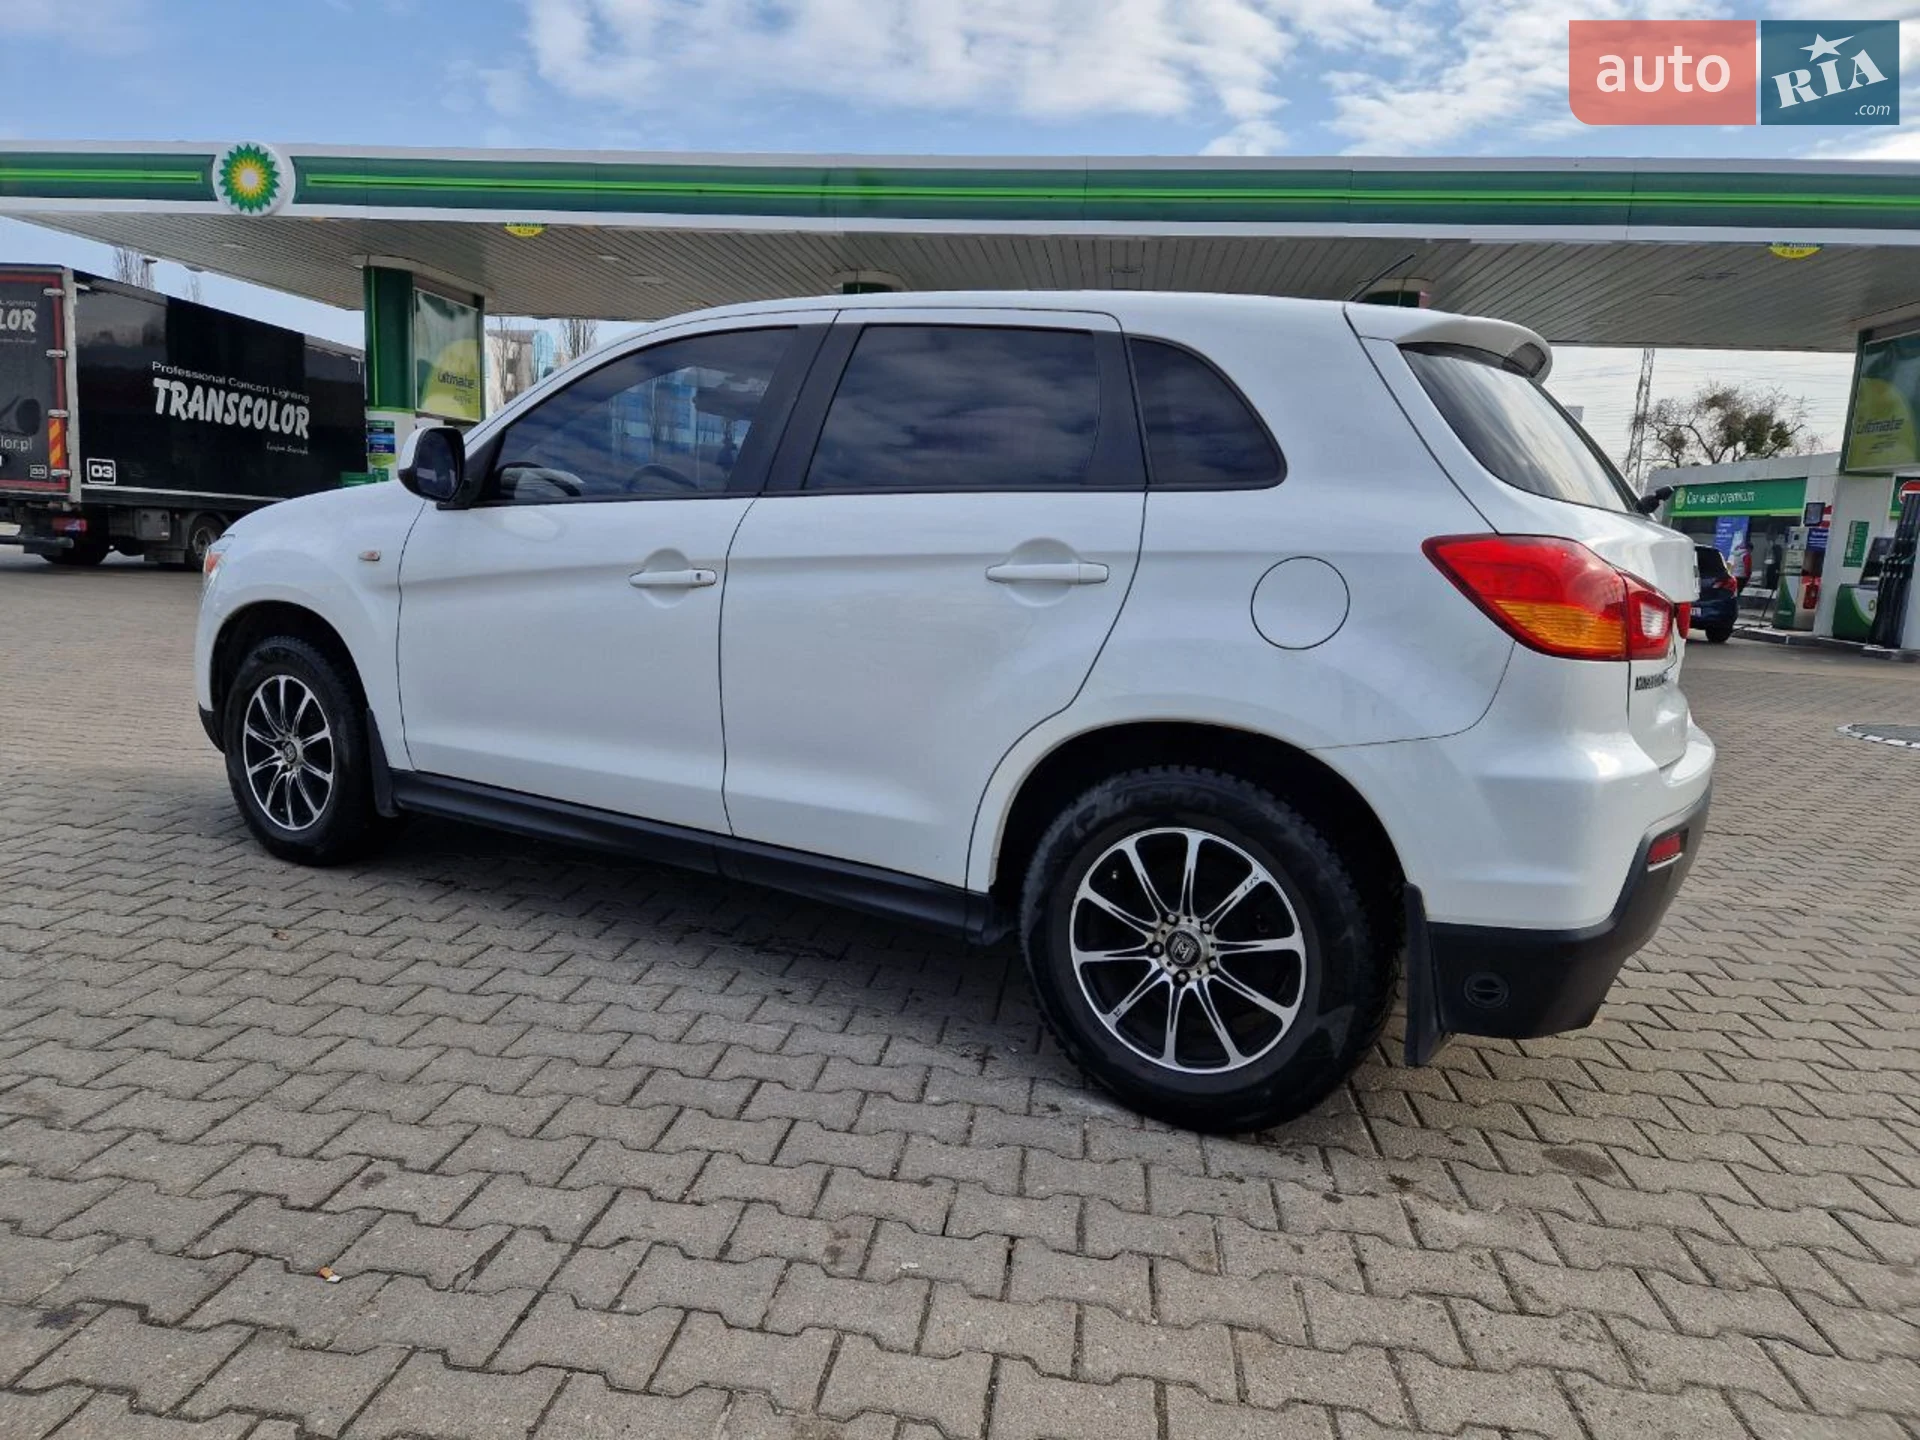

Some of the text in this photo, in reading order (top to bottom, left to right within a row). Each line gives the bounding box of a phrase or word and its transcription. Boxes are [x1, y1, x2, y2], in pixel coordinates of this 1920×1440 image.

[152, 361, 310, 405] Professional Concert Lighting
[153, 377, 310, 440] TRANSCOLOR
